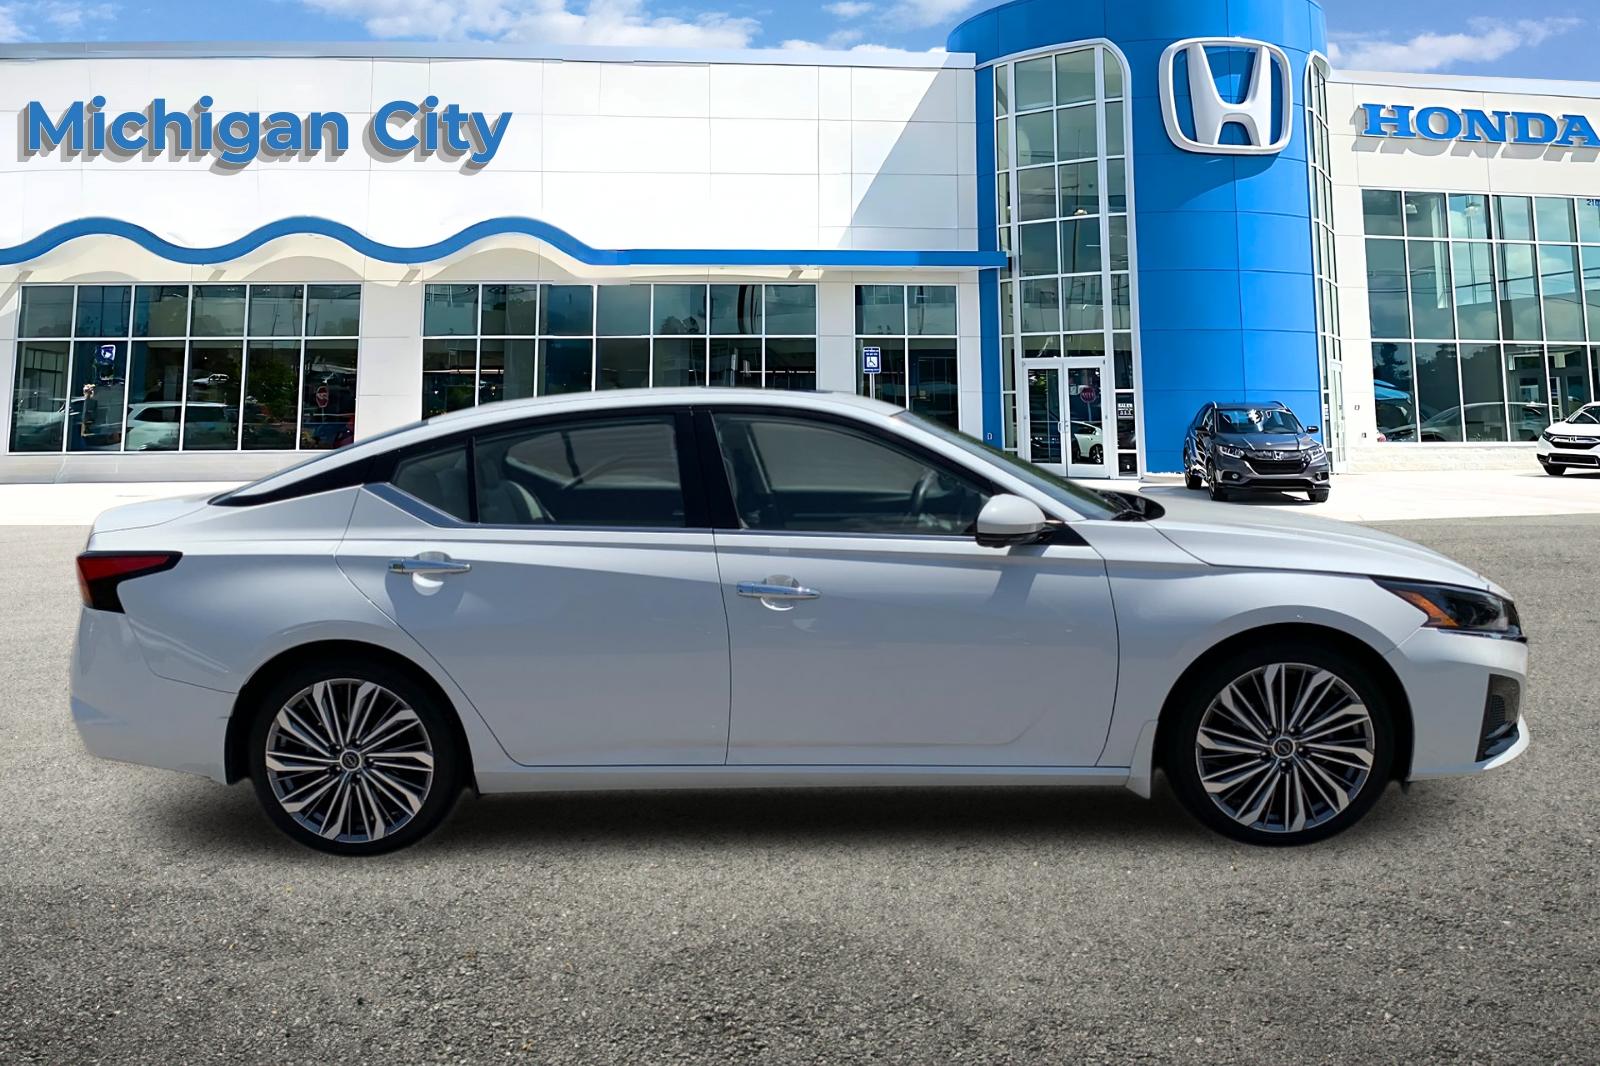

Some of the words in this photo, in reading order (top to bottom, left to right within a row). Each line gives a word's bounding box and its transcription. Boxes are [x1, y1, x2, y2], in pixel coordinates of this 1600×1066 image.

[29, 95, 349, 164] Michigan
[373, 95, 513, 164] City
[1361, 103, 1600, 147] HONDA
